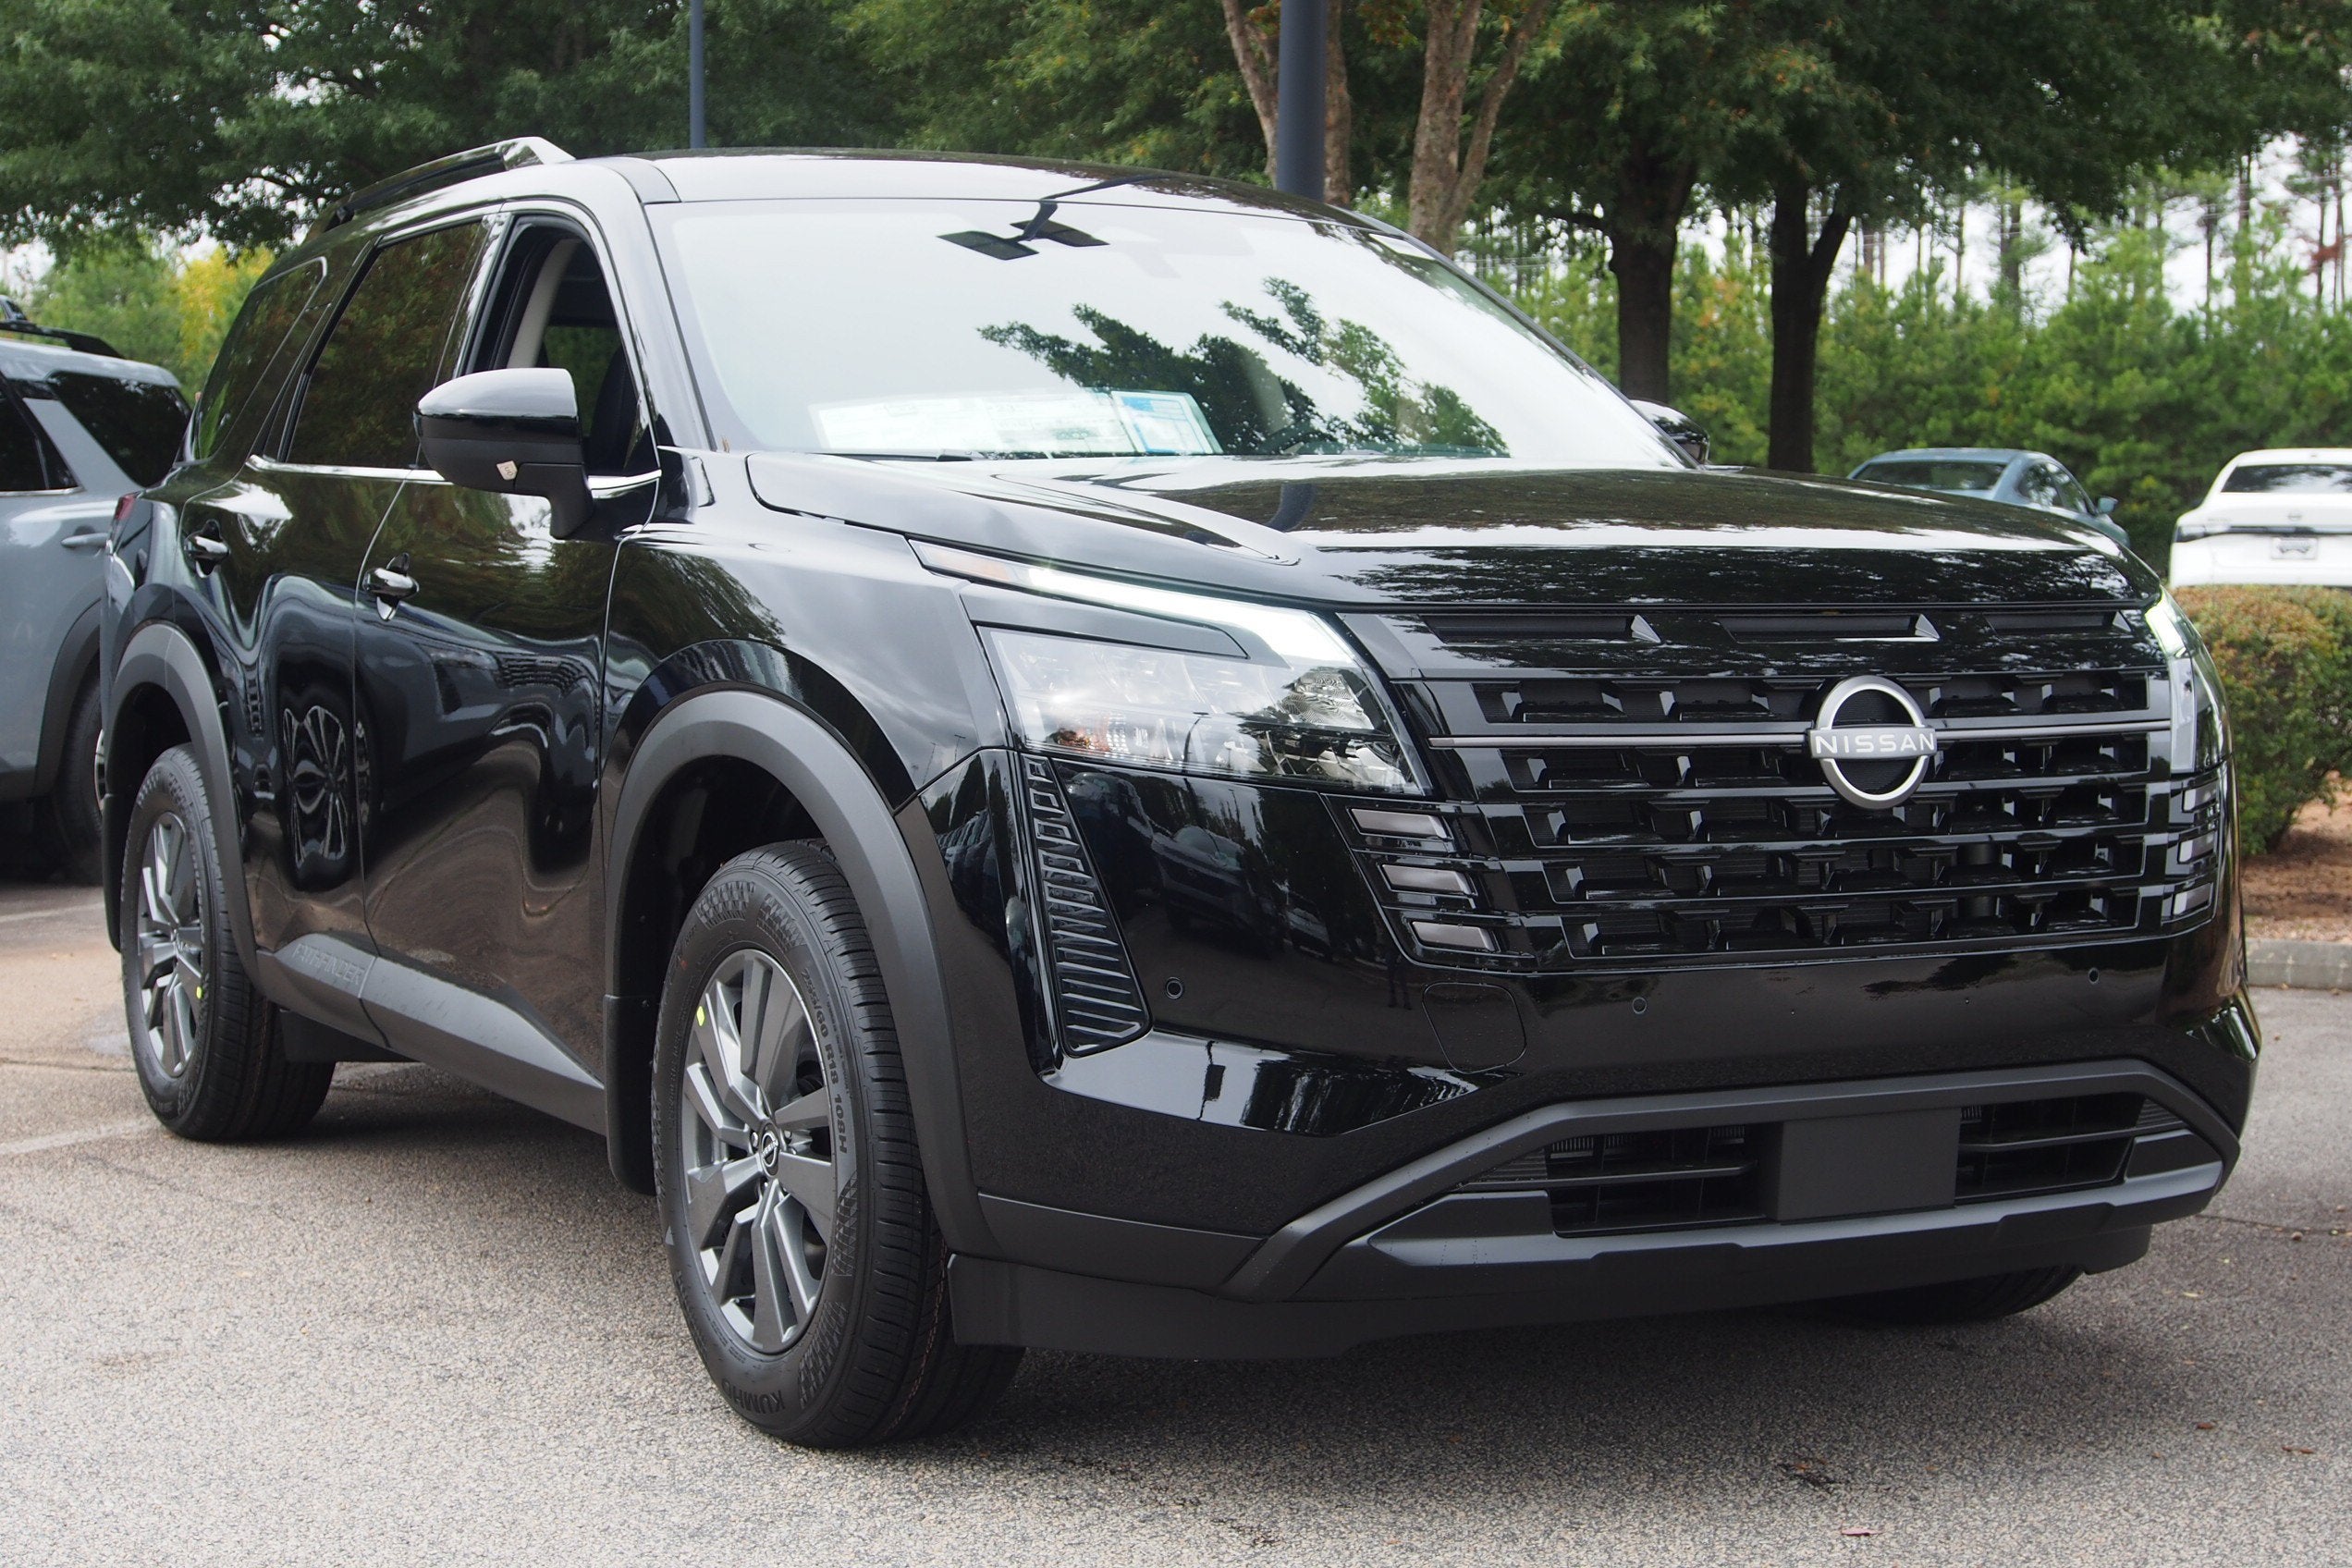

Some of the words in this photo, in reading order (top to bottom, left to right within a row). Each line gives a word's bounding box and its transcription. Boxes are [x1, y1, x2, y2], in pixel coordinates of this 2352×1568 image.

[1814, 732, 1935, 754] NISSAN
[291, 942, 366, 986] PATHFINDER
[825, 1043, 839, 1085] R18
[833, 1093, 848, 1155] 108H
[721, 1378, 786, 1414] KUMHO
